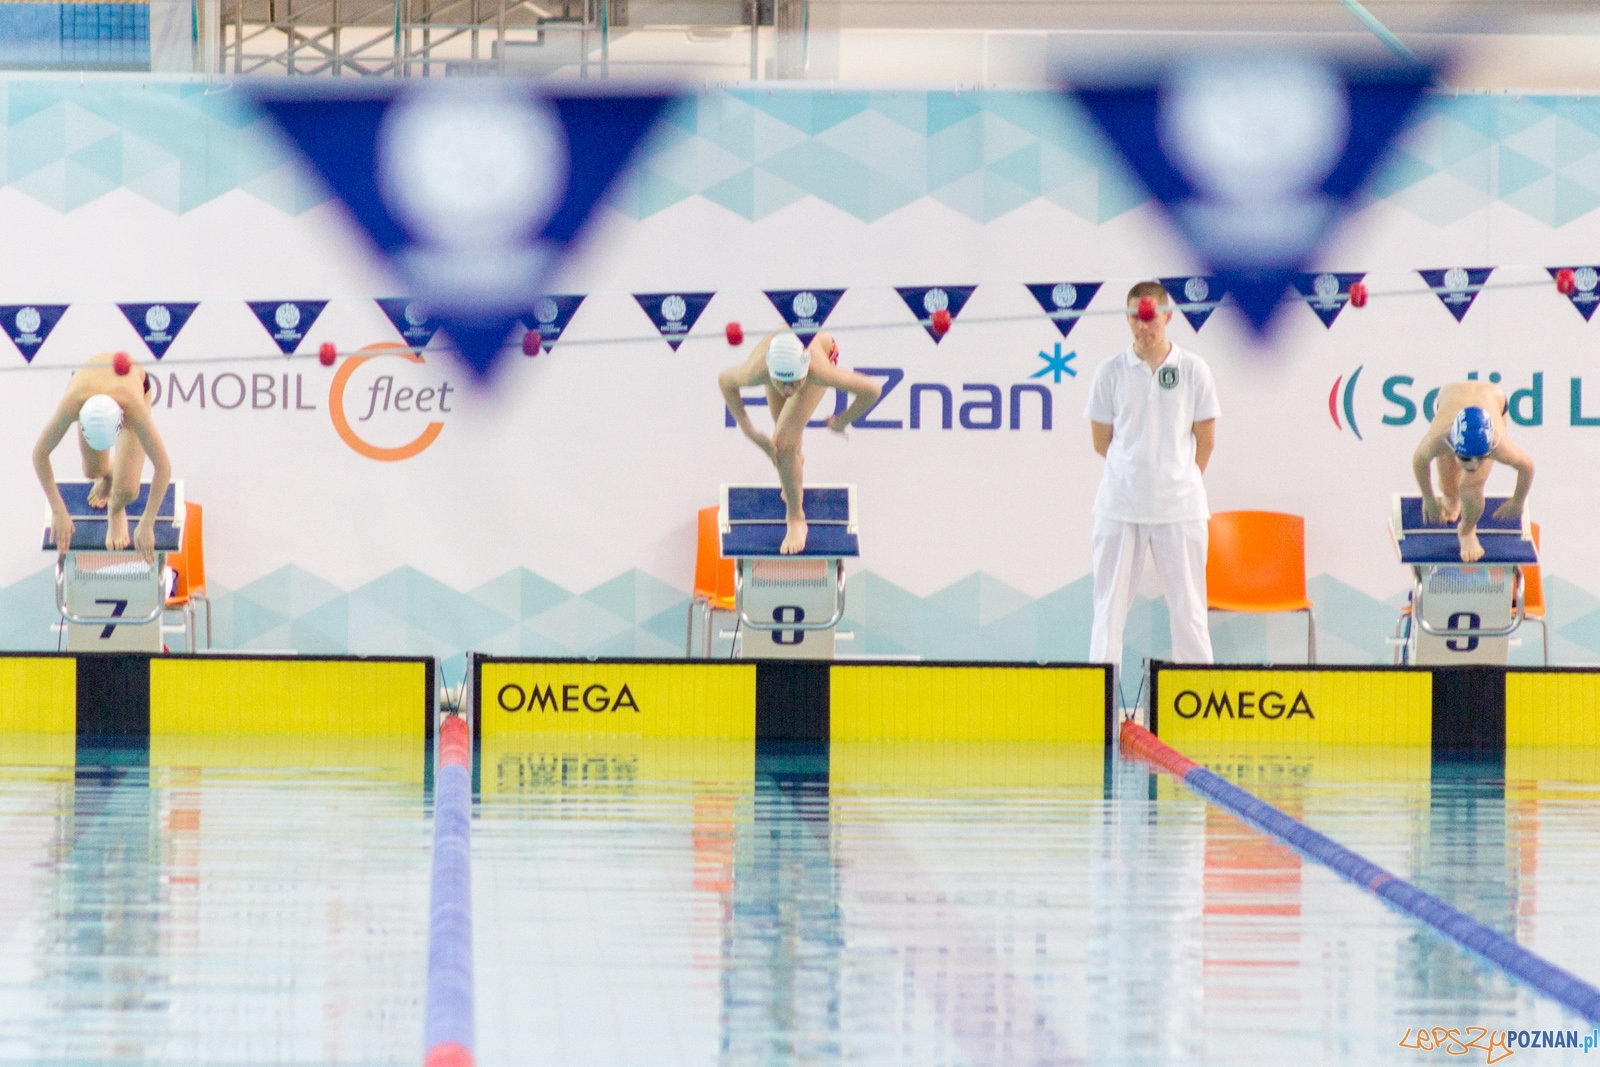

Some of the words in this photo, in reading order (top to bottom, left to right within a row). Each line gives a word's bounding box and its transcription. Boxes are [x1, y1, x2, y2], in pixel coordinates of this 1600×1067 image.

[358, 375, 455, 421] fleet
[95, 599, 128, 639] 7
[771, 605, 805, 645] 8
[1446, 612, 1480, 651] 9
[497, 683, 640, 713] OMEGA
[1174, 690, 1315, 720] OMEGA
